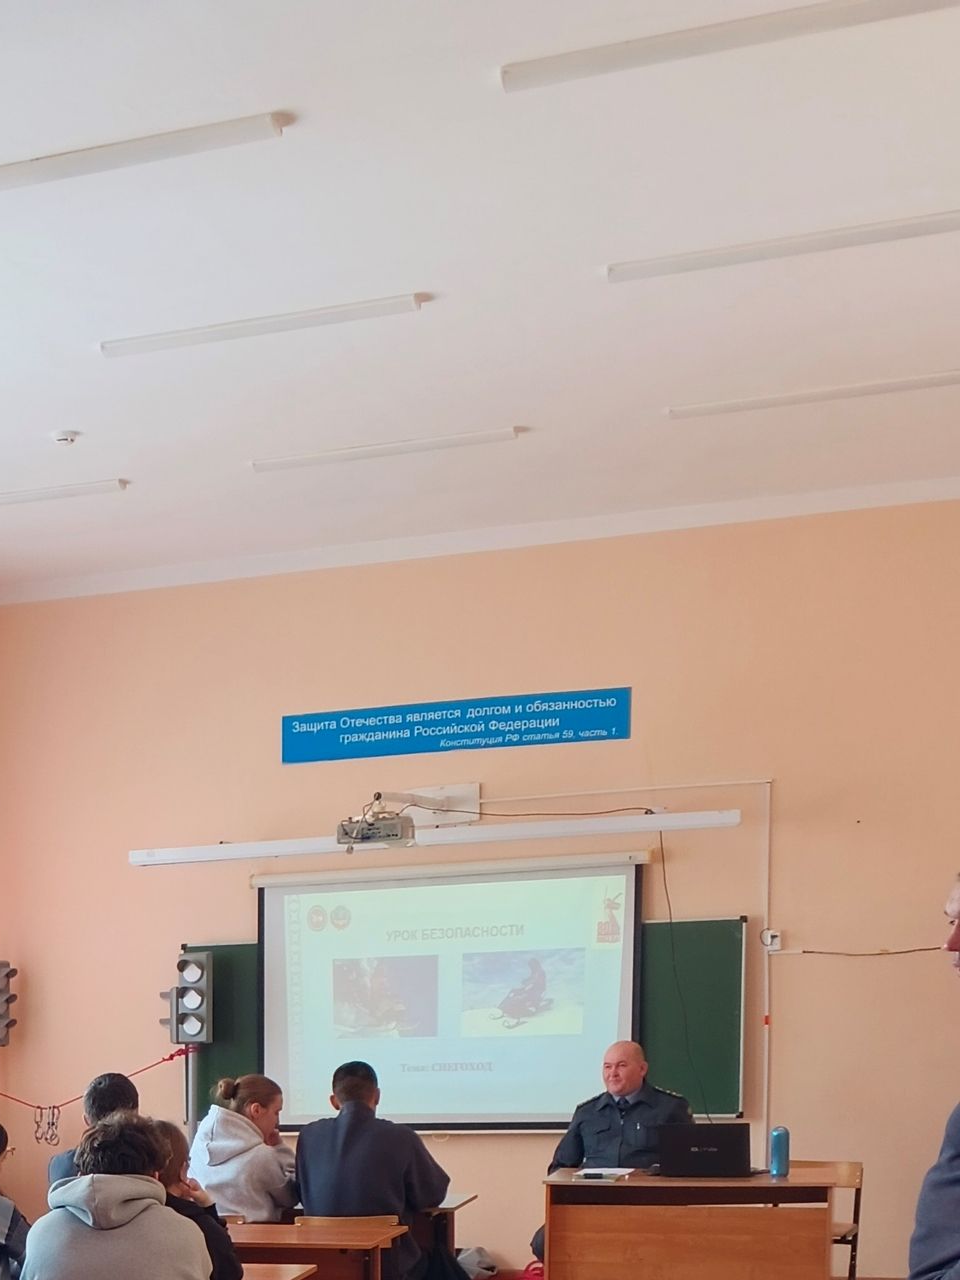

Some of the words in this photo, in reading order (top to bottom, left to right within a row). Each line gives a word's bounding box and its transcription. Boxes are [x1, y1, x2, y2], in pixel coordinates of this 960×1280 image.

[292, 721, 337, 734] Защита
[340, 715, 402, 729] Отечества
[406, 708, 461, 722] является
[466, 705, 511, 719] долгом
[514, 705, 523, 714] и
[526, 697, 617, 712] обязанностью
[339, 729, 411, 745] гражданина
[414, 721, 485, 737] Российской
[488, 717, 560, 731] Федерации
[440, 736, 503, 748] Конституция
[505, 733, 520, 742] РФ
[522, 732, 560, 742] статья
[386, 929, 418, 942] УРОК
[421, 924, 525, 940] БЕЗОПАСНОСТИ
